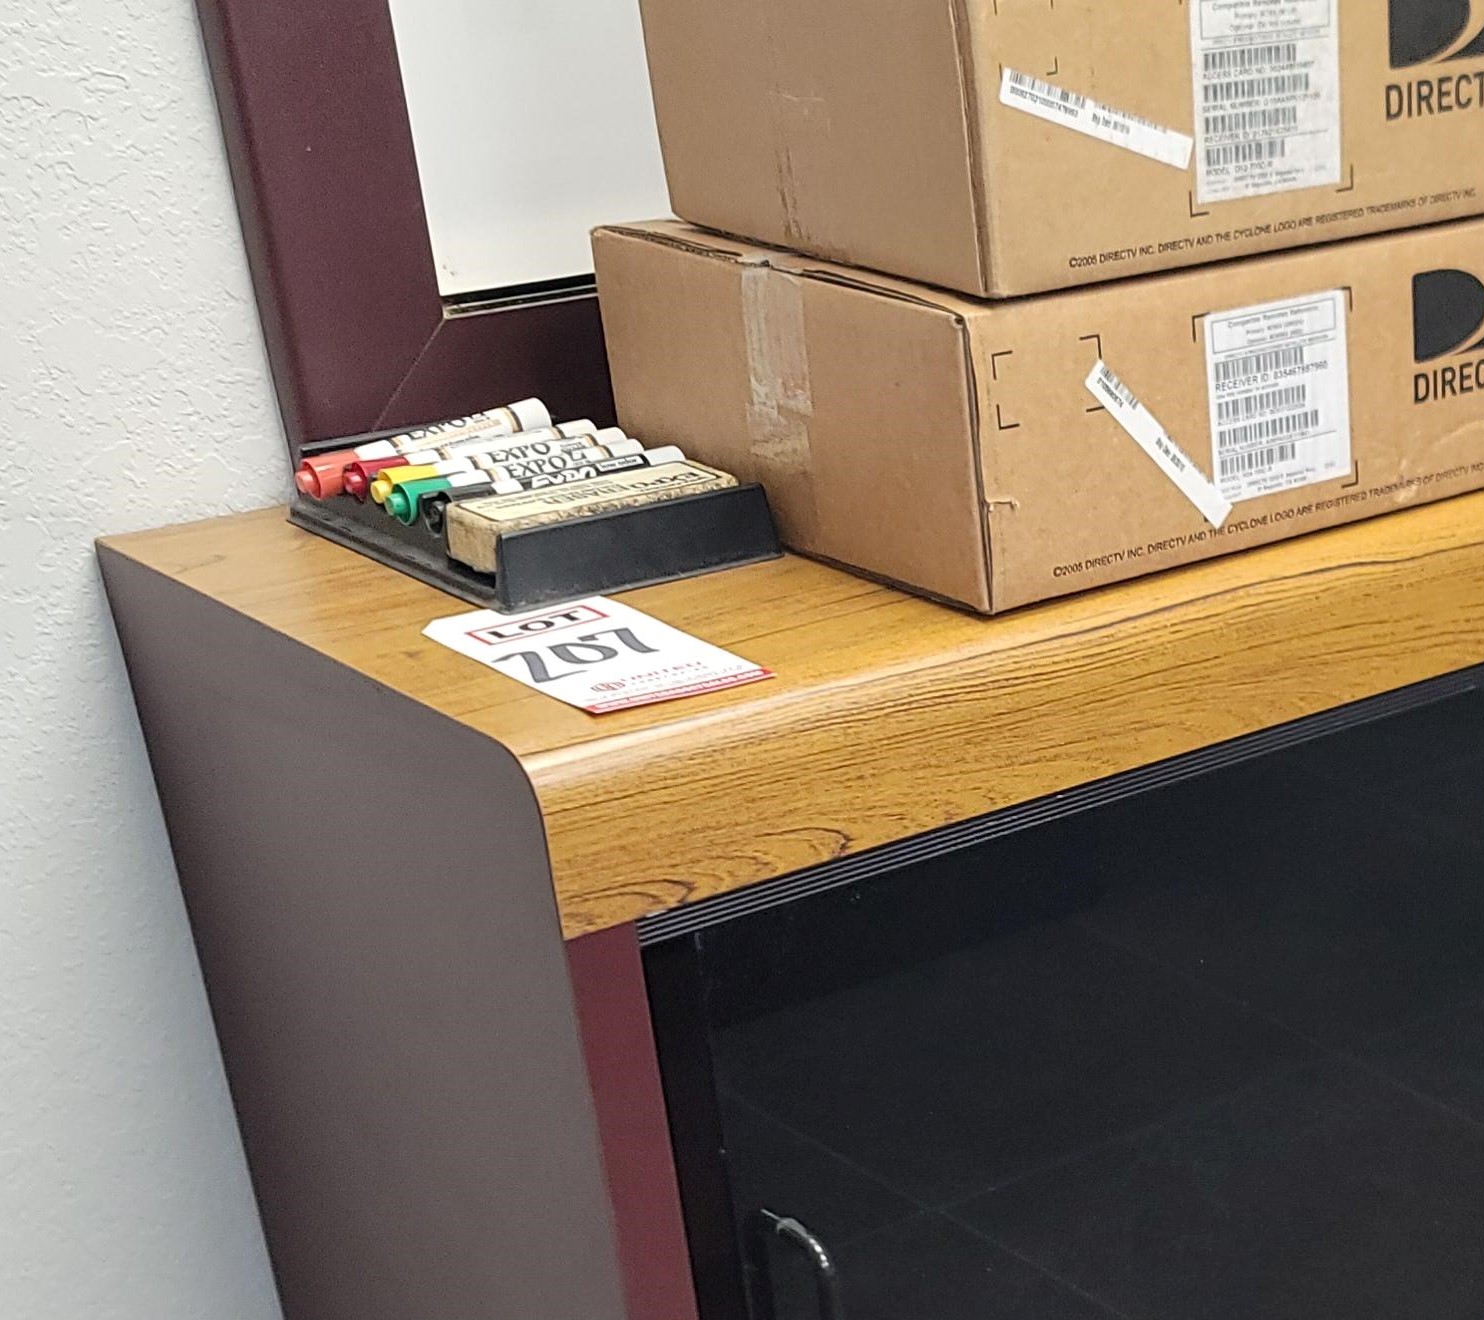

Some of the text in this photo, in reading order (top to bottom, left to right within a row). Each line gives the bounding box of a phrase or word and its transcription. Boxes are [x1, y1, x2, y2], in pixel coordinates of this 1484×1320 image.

[1099, 248, 1137, 264] DIRECTV
[1157, 237, 1194, 254] DIRECTV
[1196, 234, 1213, 246] AND
[1215, 231, 1231, 242] THE
[1233, 223, 1272, 239] CYCLONE
[1273, 218, 1297, 233] LOGO
[488, 441, 552, 464] EXPO
[504, 455, 568, 479] EXPO
[1085, 550, 1126, 569] DIRECTV
[1147, 535, 1187, 554] DIRECTV
[1187, 530, 1207, 545] AND
[1208, 525, 1226, 538] THE
[1227, 514, 1268, 535] CYCLONE
[1269, 508, 1295, 524] LOGO
[1296, 502, 1315, 517] ARE
[1315, 490, 1368, 513] REGISTERED
[486, 610, 581, 639] LOT
